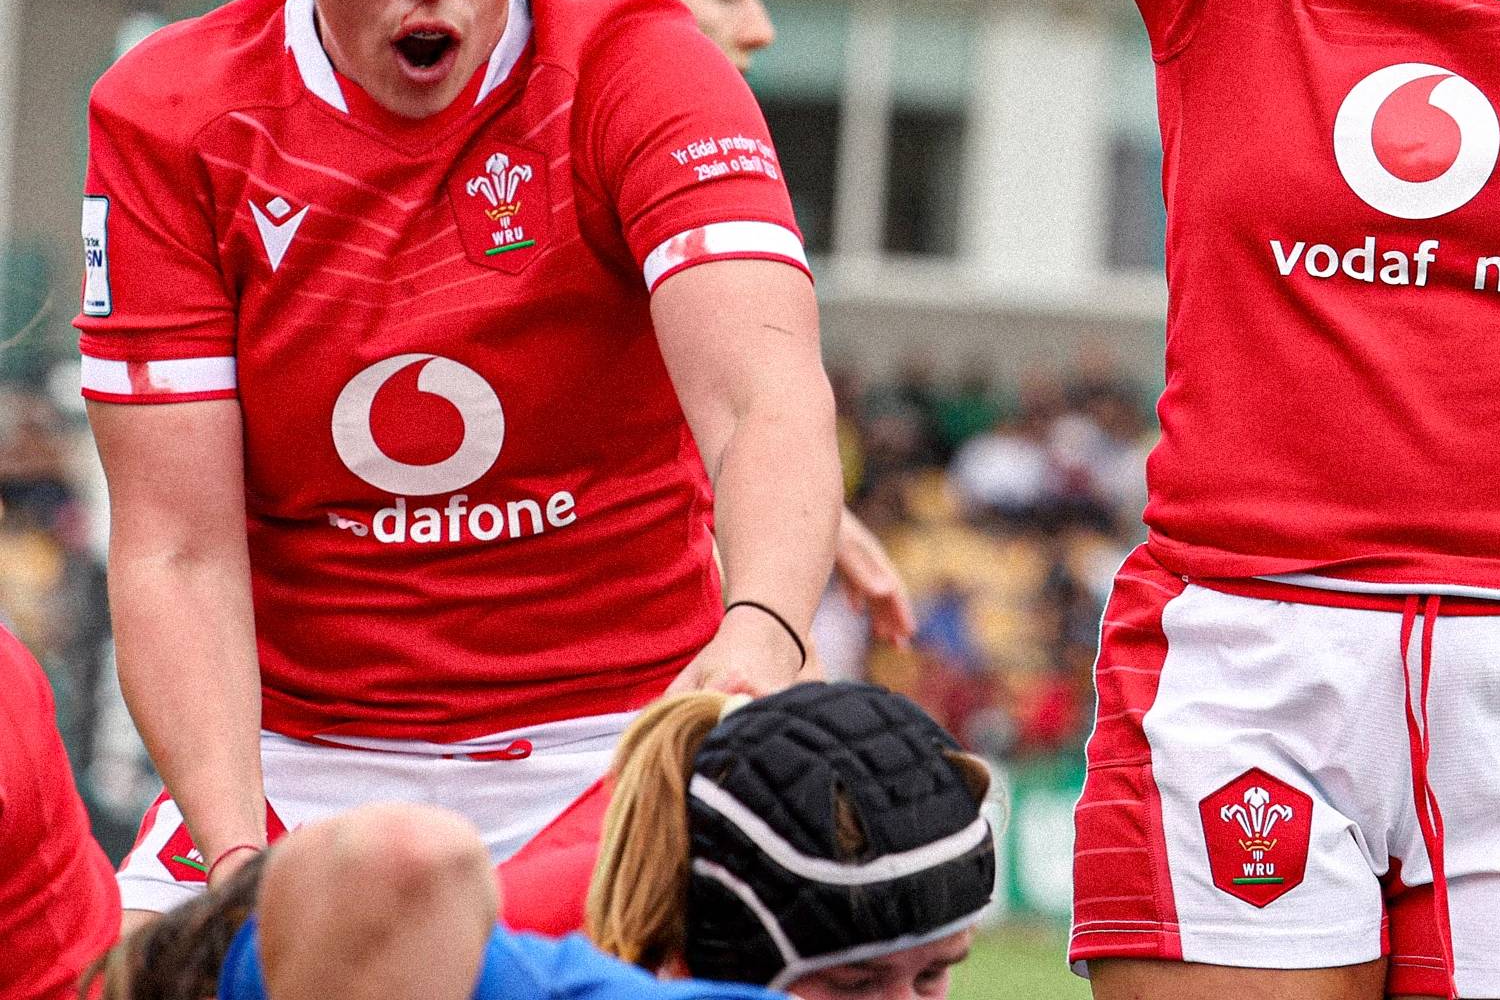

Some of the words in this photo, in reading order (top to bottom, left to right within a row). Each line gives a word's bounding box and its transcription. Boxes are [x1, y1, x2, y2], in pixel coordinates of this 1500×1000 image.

[671, 149, 688, 165] Yr
[687, 137, 718, 160] Eidal
[694, 160, 730, 181] 29ain
[492, 226, 524, 246] WRU
[1242, 862, 1275, 876] WRU
